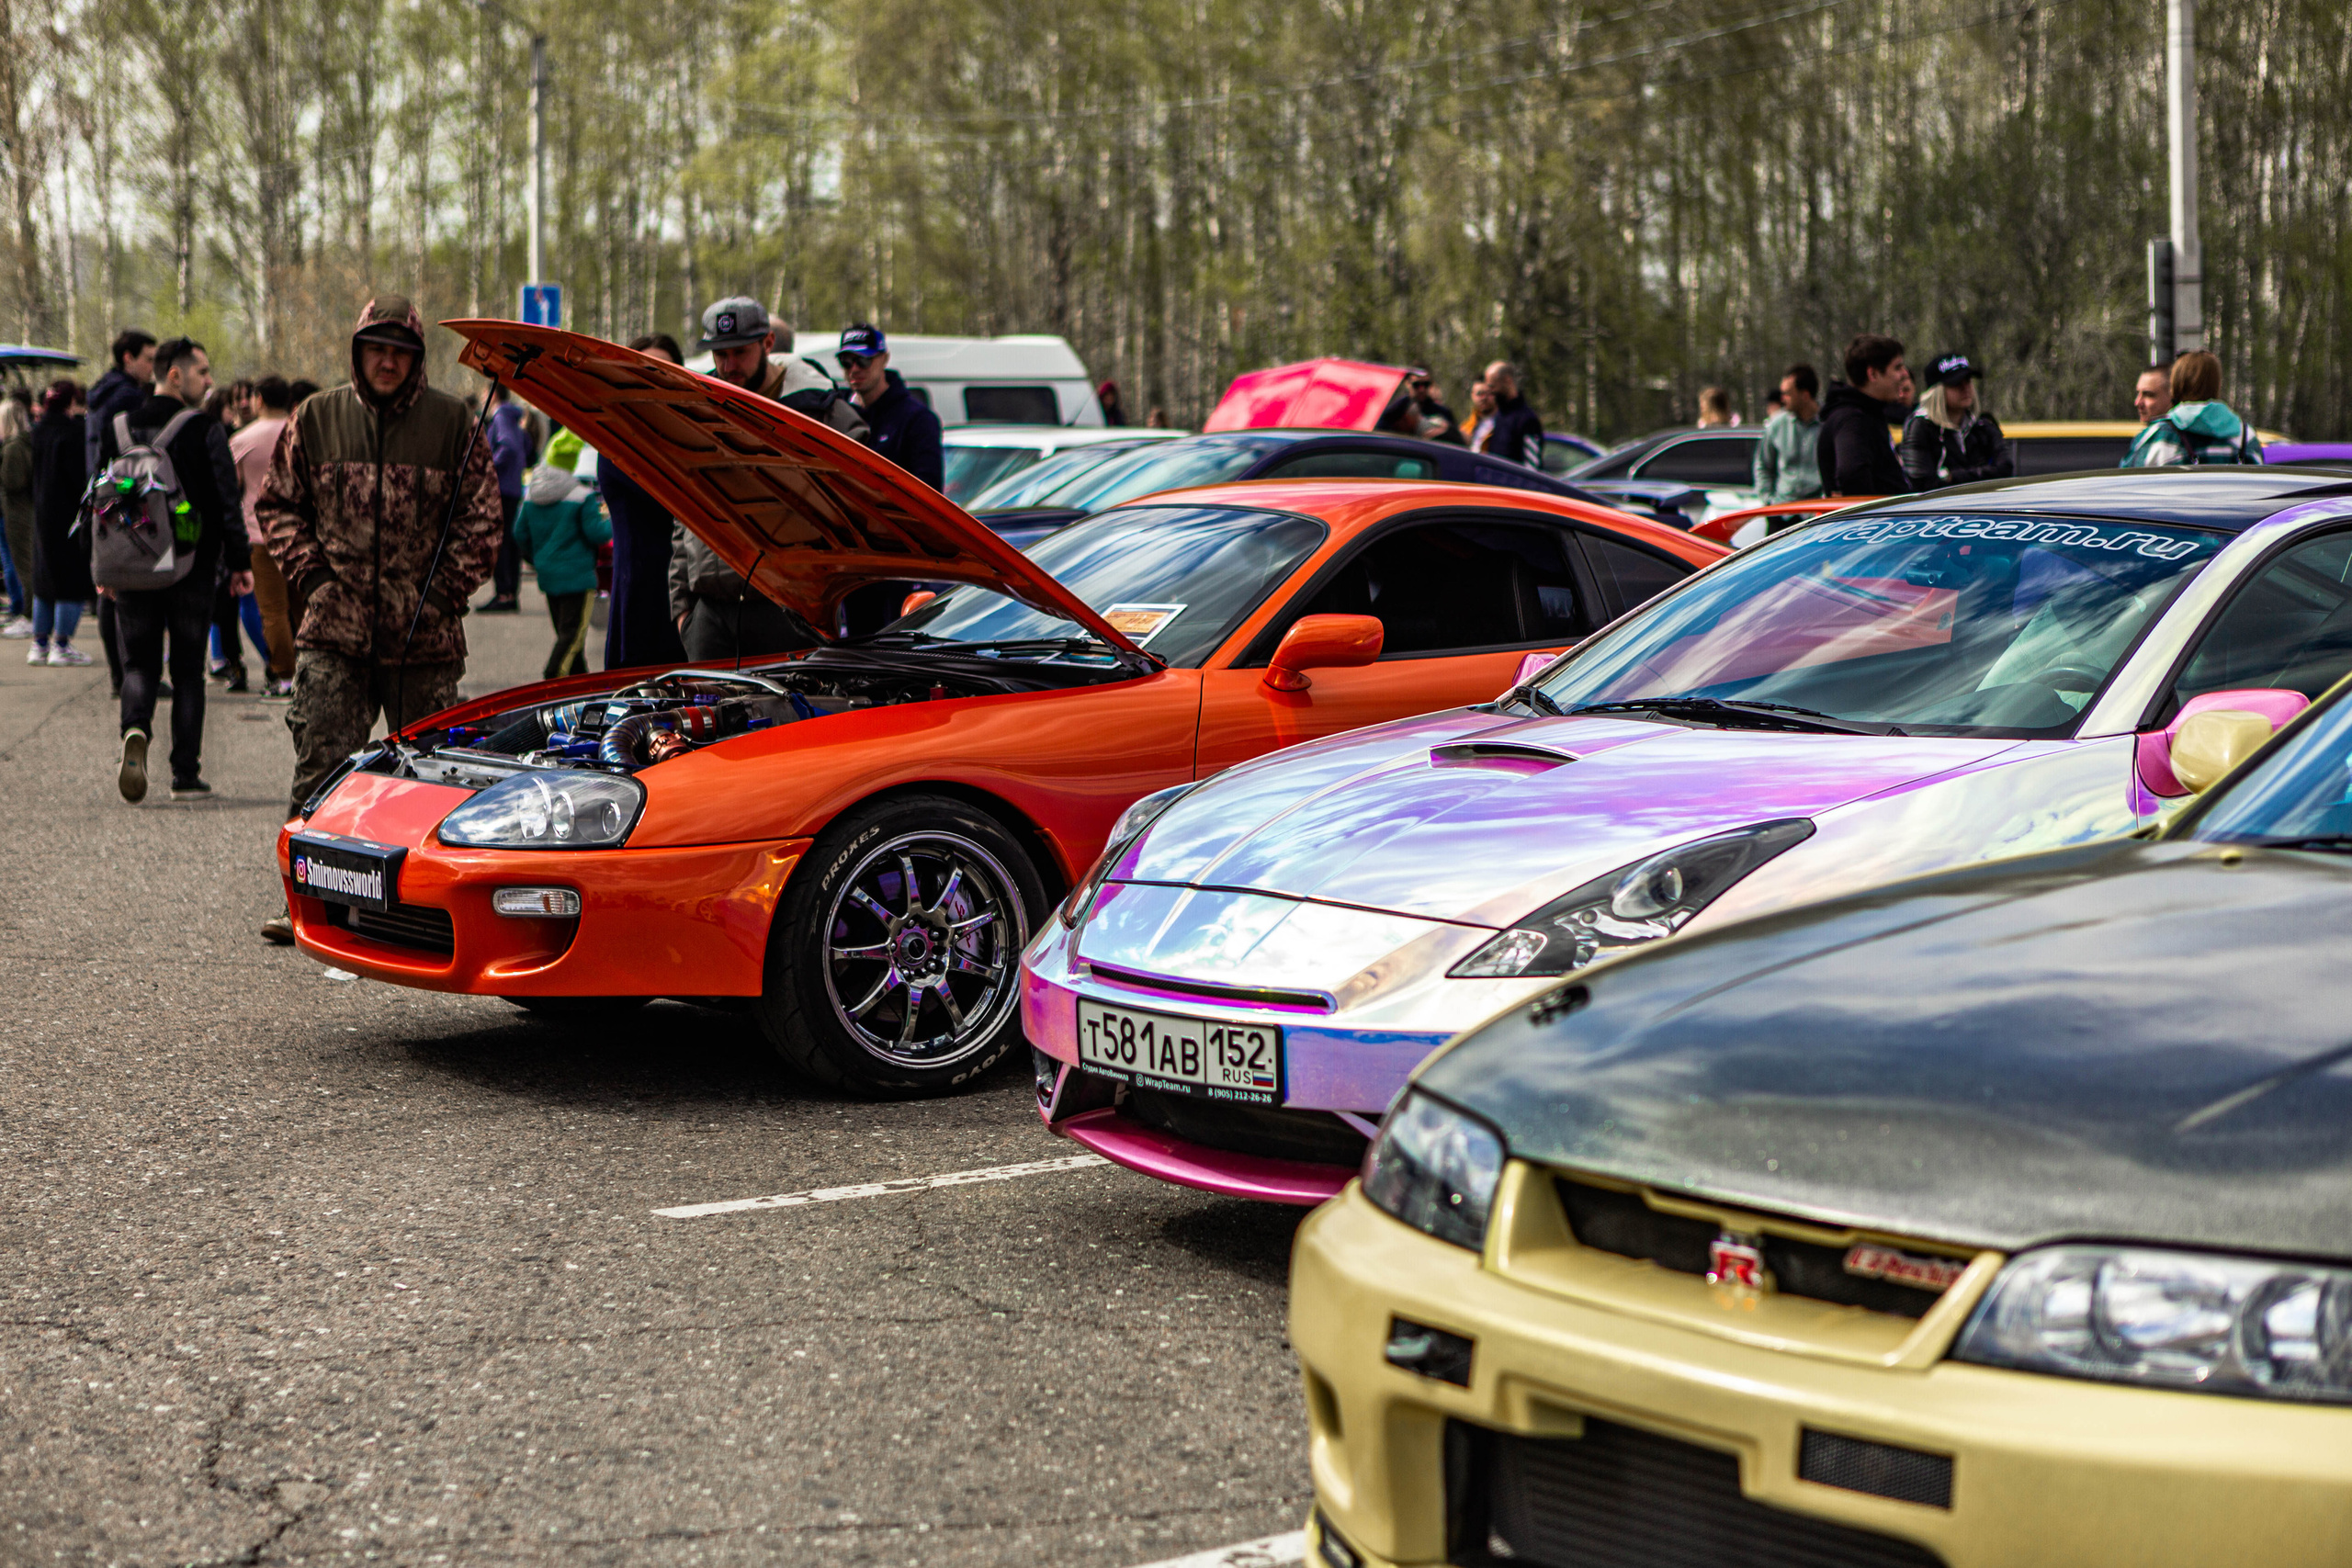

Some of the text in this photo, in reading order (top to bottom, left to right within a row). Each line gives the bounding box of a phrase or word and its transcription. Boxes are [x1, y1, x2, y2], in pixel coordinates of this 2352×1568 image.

[306, 855, 383, 901] Smirnovssworld
[821, 826, 880, 891] PROXES
[951, 1043, 1010, 1085] TOYO
[1087, 1011, 1200, 1076] Т581АВ
[1209, 1025, 1266, 1071] 152
[1144, 1076, 1192, 1094] WrapTeam.ru
[1208, 1088, 1272, 1103] 8 (905) 212-26-26
[1223, 1067, 1251, 1085] RUS
